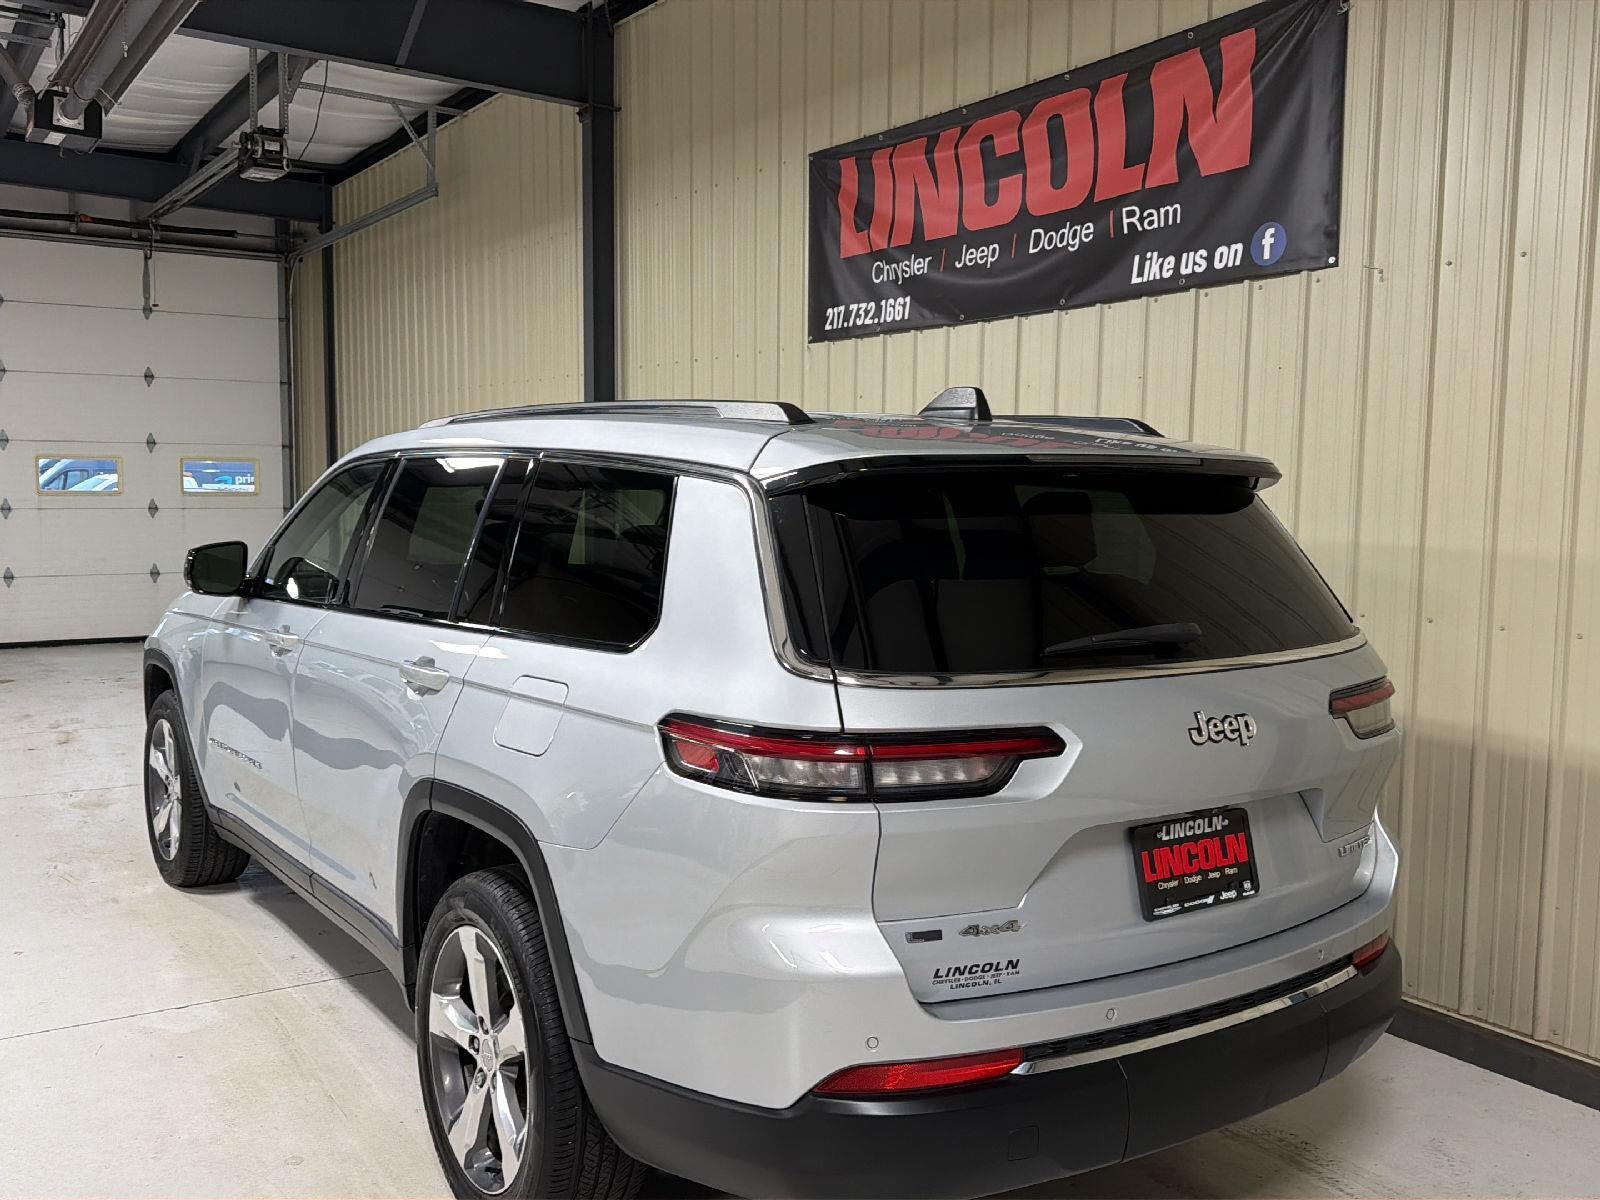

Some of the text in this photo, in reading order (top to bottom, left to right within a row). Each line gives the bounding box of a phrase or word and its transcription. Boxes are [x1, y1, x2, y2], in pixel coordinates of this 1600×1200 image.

[838, 28, 1257, 258] LINCOLN
[872, 203, 1182, 285] Chrysler Jeep Dodge Ram
[1130, 251, 1176, 284] Like
[1179, 248, 1208, 275] us
[1213, 242, 1244, 269] on
[824, 295, 911, 331] 217.732.1661
[1188, 711, 1257, 746] Jeep
[1161, 815, 1222, 841] LINCOLN
[1141, 832, 1249, 883] LINCOLN
[1157, 867, 1239, 890] Chrysler Dodge Jeep Ram
[1220, 889, 1238, 900] Jeep
[959, 919, 1021, 937] 4x4
[933, 959, 1020, 979] LINCOLN
